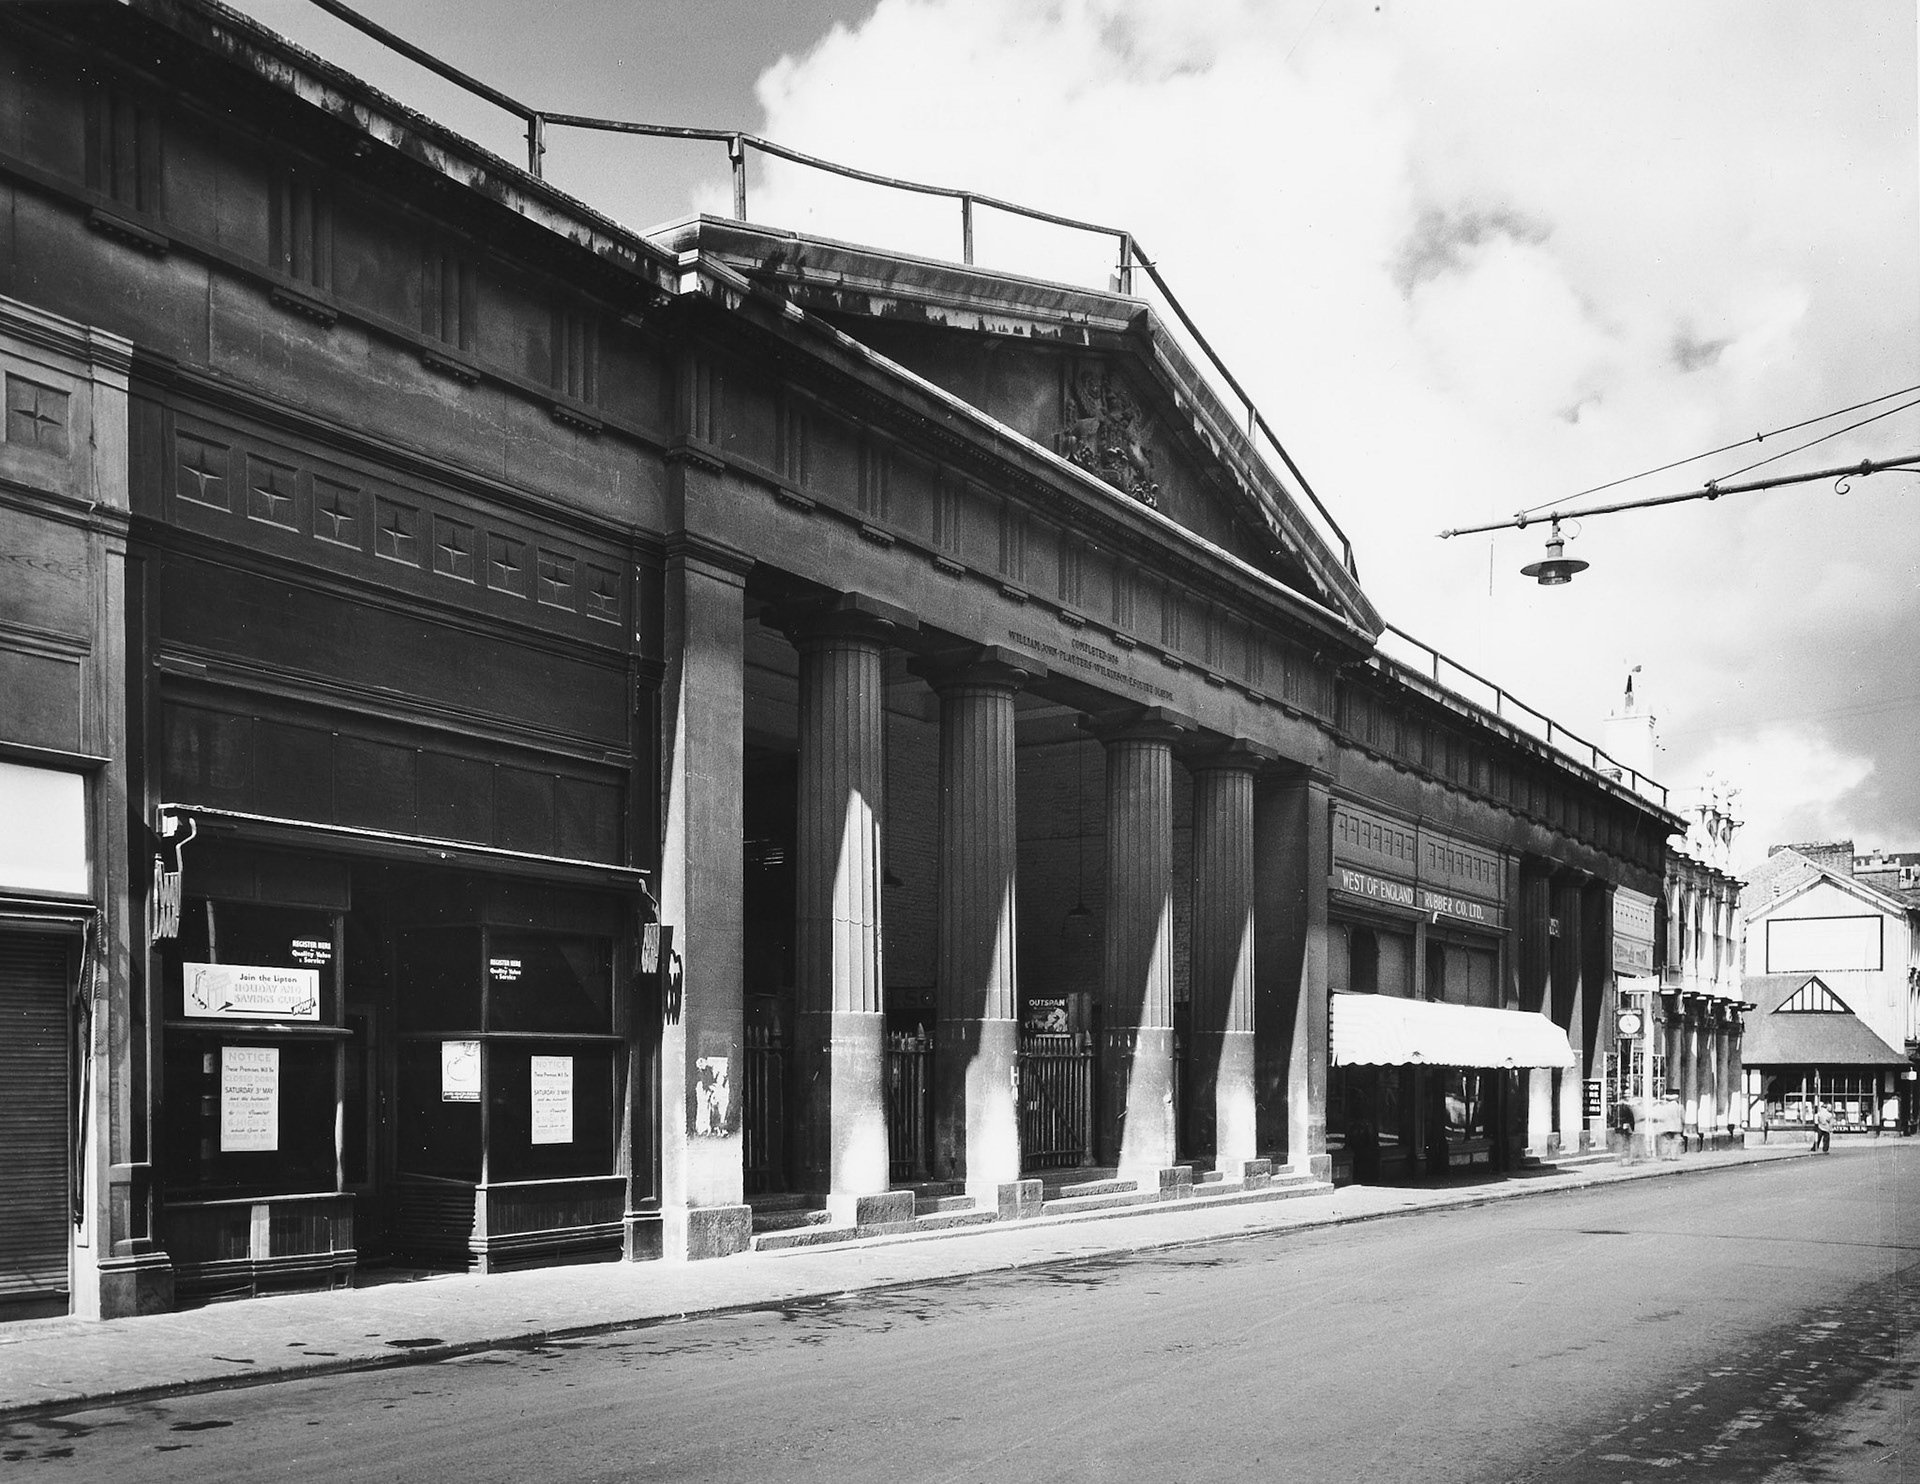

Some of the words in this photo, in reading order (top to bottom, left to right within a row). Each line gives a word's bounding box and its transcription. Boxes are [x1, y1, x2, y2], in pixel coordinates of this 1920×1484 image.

[1342, 869, 1365, 893] WEST
[1367, 877, 1378, 896] OF
[1380, 881, 1414, 904] ENGLAND
[1424, 892, 1453, 913] RUBBER
[291, 949, 315, 959] Quality
[315, 950, 332, 959] Value
[303, 956, 326, 965] Service
[489, 967, 508, 976] Quality
[240, 973, 256, 982] Join
[259, 974, 271, 982] the
[274, 975, 297, 985] Lipton
[499, 973, 517, 981] Service
[234, 983, 278, 994] HOLIDAY
[280, 985, 302, 995] AND
[234, 993, 274, 1004] SAVINGS
[229, 1052, 271, 1062] NOTICE
[536, 1060, 567, 1069] NOTICE
